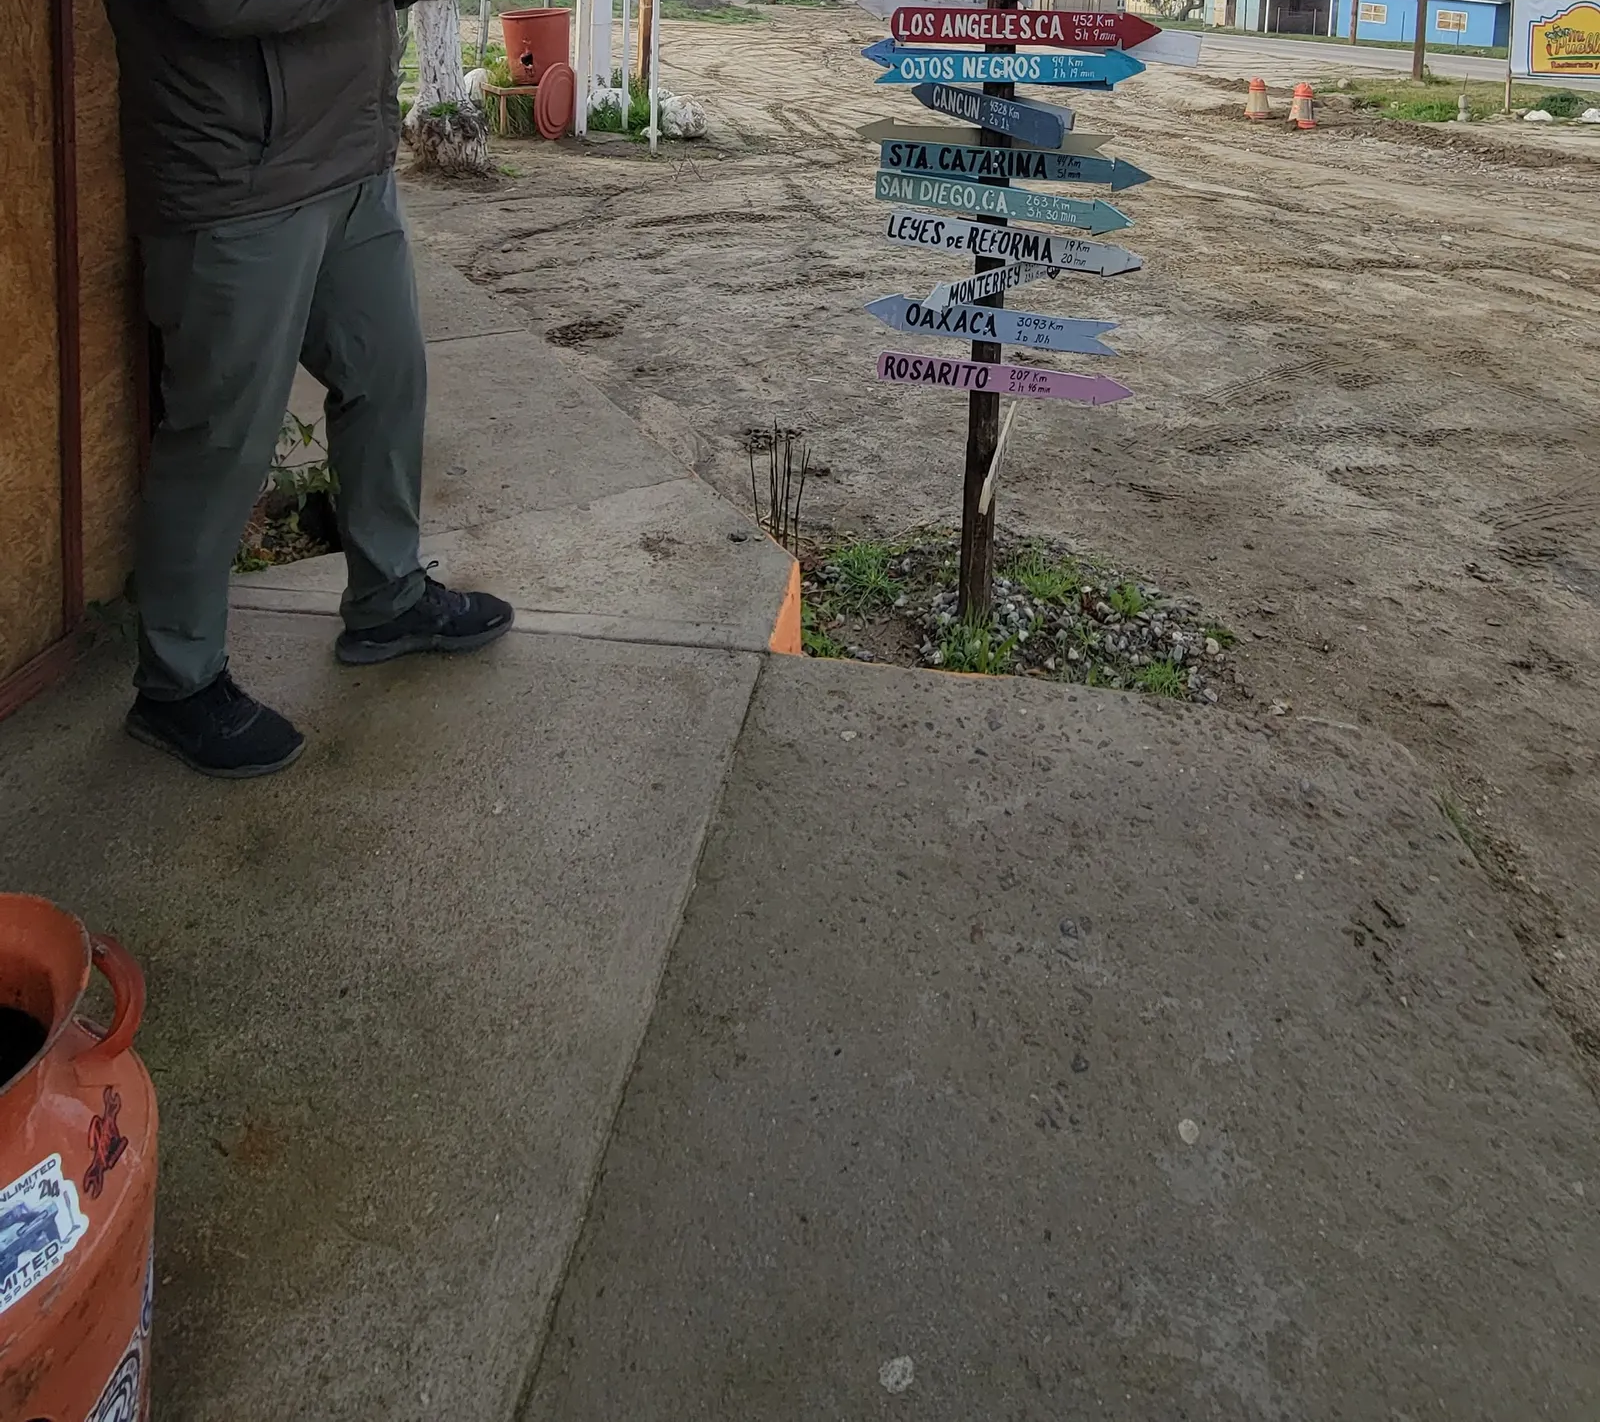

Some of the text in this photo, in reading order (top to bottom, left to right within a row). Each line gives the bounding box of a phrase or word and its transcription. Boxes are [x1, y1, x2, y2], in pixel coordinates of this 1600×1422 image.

[899, 12, 936, 36] LOS
[1072, 14, 1114, 27] 452 Km
[1074, 28, 1088, 40] 5h
[900, 56, 1041, 81] OJOS NEGROS
[1052, 56, 1083, 67] 99 Km
[1053, 68, 1066, 78] 1h
[1070, 67, 1078, 78] 19
[1008, 106, 1020, 120] Km
[889, 143, 1048, 179] STA. CATARINA
[1068, 157, 1081, 168] Km
[880, 175, 914, 200] SAN
[1026, 194, 1070, 210] 263 Km
[1026, 207, 1077, 223] 3h 30 min
[887, 214, 945, 245] LEYES
[966, 226, 1053, 263] REFORMA
[1064, 240, 1090, 253] 19 Km
[1061, 253, 1073, 264] 20
[949, 264, 1021, 305] MONTERREY
[906, 303, 998, 337] OAXACA
[1016, 317, 1064, 331] 3093 Km
[884, 355, 990, 389] ROSARITO
[1009, 369, 1048, 382] 207 Km
[1028, 383, 1038, 393] 46
